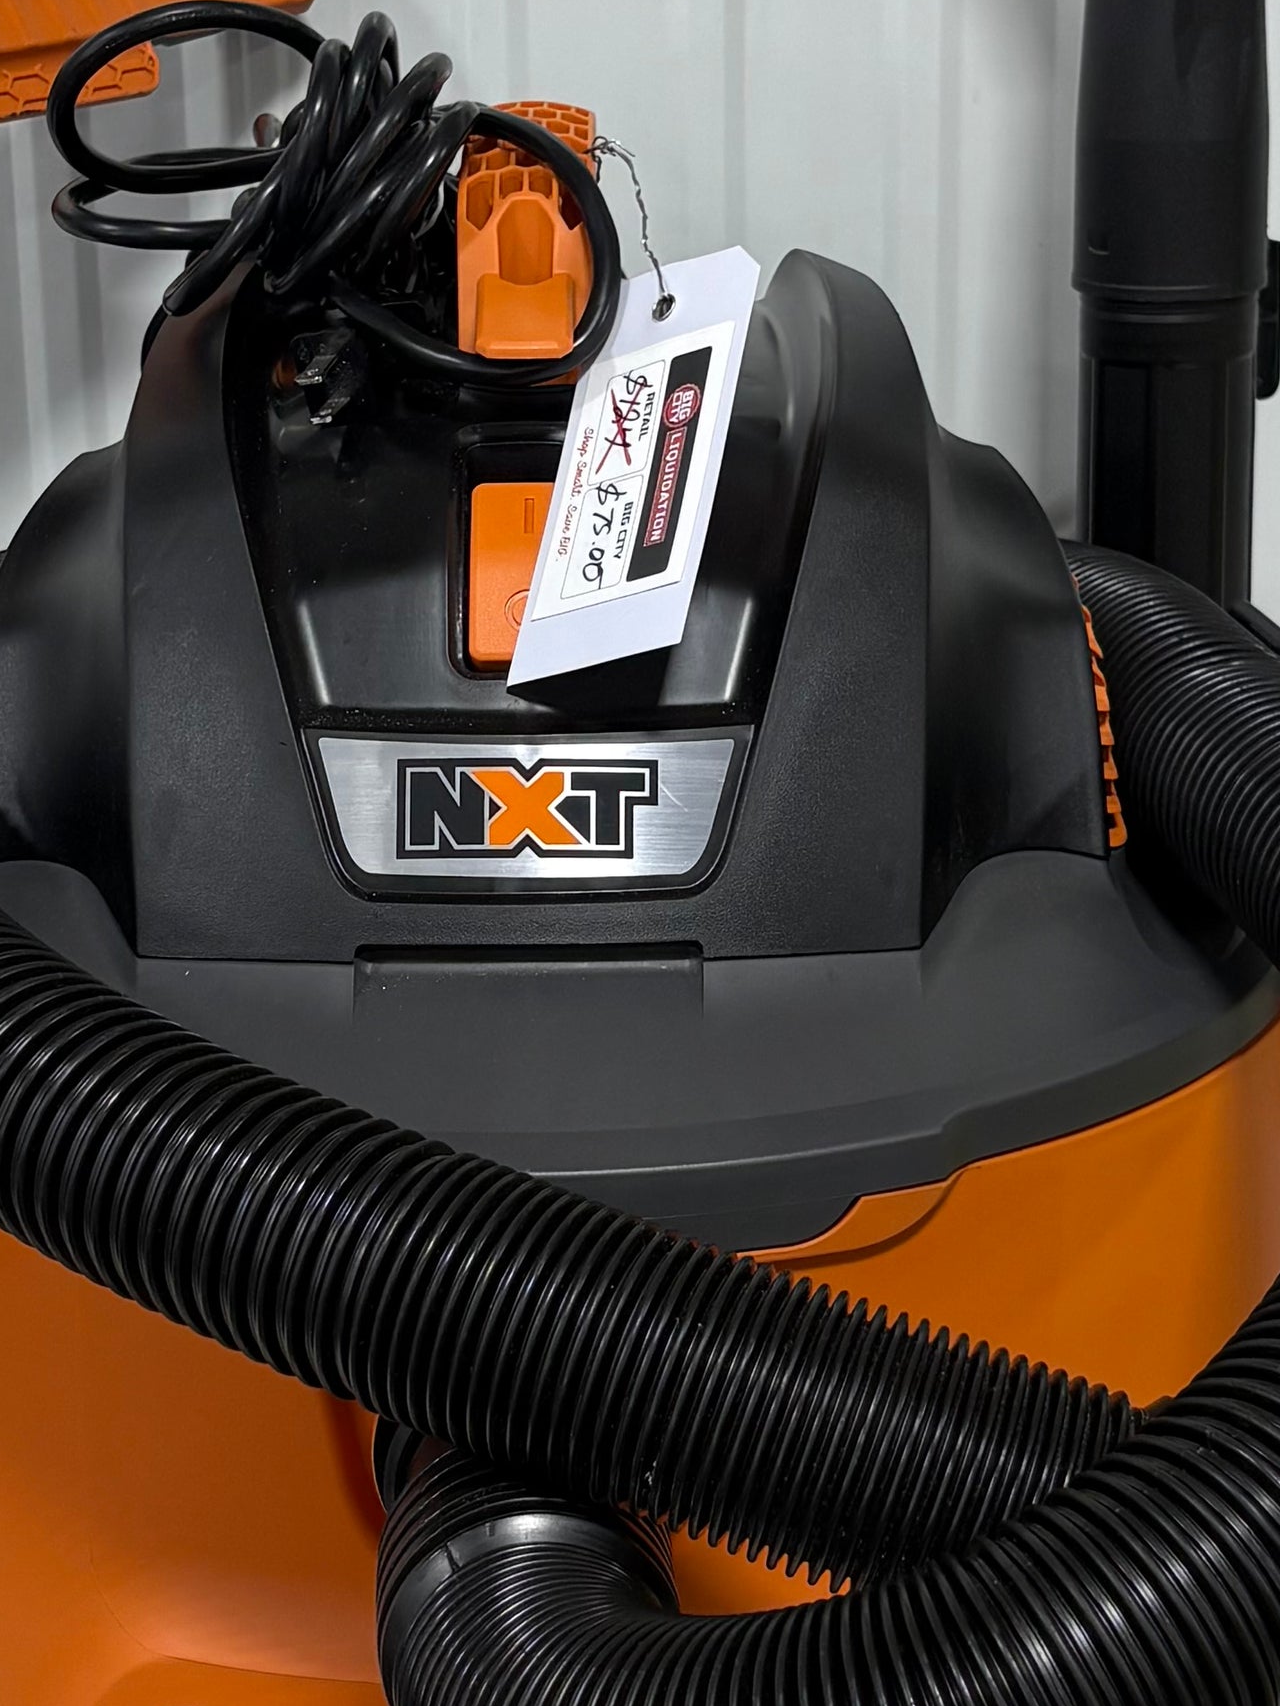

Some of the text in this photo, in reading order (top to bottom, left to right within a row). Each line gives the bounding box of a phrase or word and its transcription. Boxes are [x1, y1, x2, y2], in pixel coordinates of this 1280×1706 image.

[638, 391, 656, 442] RETAIL
[668, 389, 682, 424] CITY
[677, 389, 695, 421] BIG
[576, 426, 594, 458] Shop
[649, 431, 684, 543] LIQUIDATION
[582, 481, 627, 590] $75.00
[613, 501, 634, 560] BIG CITY
[398, 759, 657, 858] NXT
